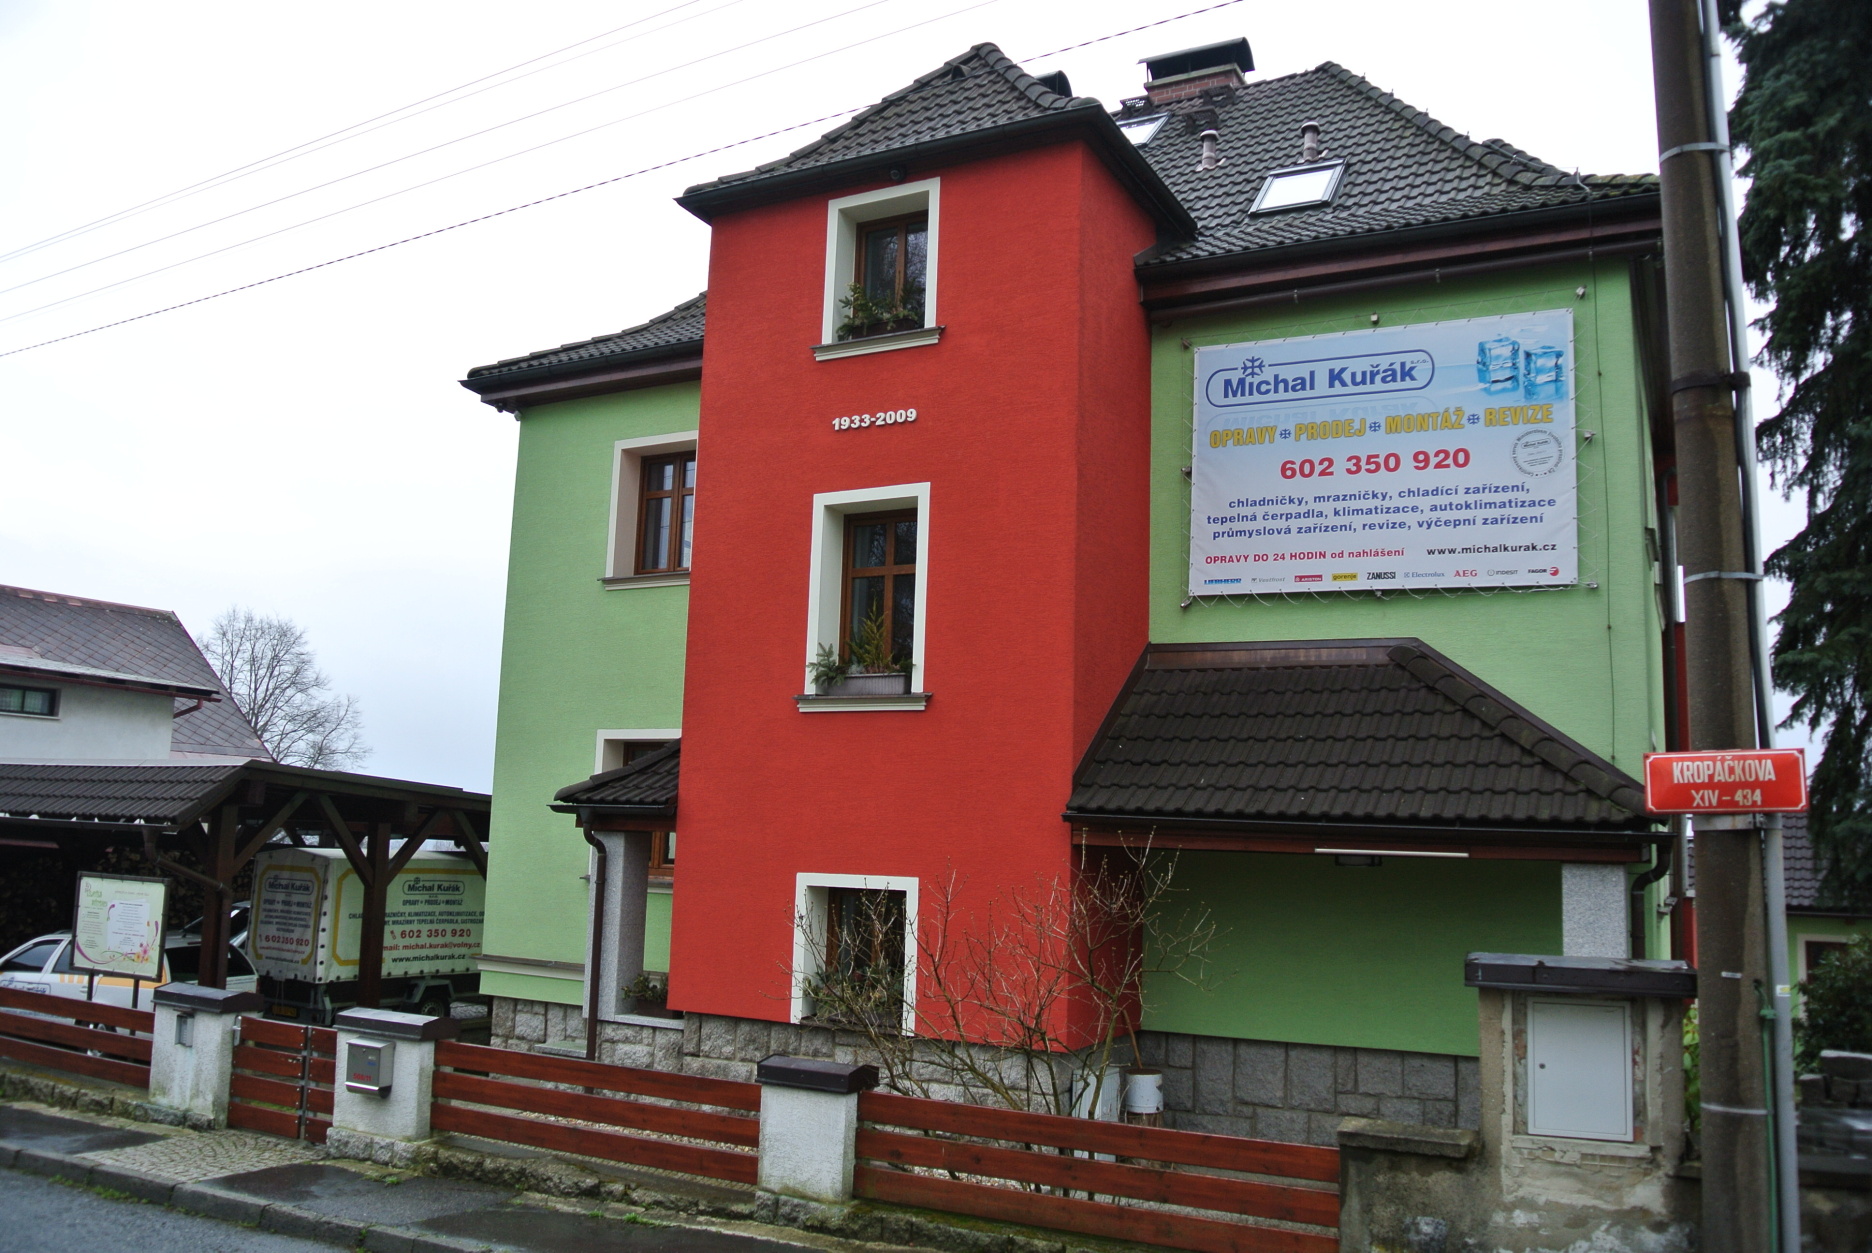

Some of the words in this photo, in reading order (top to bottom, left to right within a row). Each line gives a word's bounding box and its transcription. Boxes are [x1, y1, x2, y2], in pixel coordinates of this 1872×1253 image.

[1223, 370, 1315, 399] Michal
[1328, 360, 1418, 389] Kuřák
[832, 408, 917, 431] 1933-2009
[1209, 426, 1277, 448] OPRAVY
[1295, 418, 1367, 441] PRODEJ
[1385, 407, 1465, 435] MONTÁŽ
[1484, 404, 1554, 427] REVIZE
[1279, 457, 1335, 480] 602
[1345, 452, 1402, 475] 350
[1412, 447, 1471, 470] 920
[1228, 495, 1309, 509] chladničky,
[1313, 489, 1393, 504] mrazničky,
[1398, 485, 1459, 499] chladící
[1463, 481, 1530, 495] zařízení,
[1206, 511, 1258, 526] tepelná
[1262, 508, 1329, 522] čerpadla,
[1333, 503, 1424, 518] klimatizace,
[1429, 497, 1557, 512] autoklimatizace
[1212, 525, 1292, 541] průmyslová
[1296, 521, 1357, 534] zařízení,
[1362, 519, 1412, 531] revize,
[1417, 515, 1478, 530] výčepní
[1481, 513, 1545, 526] zařízení
[1205, 554, 1250, 565] OPRAVY
[1253, 553, 1269, 563] DO
[1272, 553, 1286, 562] 24
[1289, 551, 1327, 560] HODIN
[1330, 550, 1344, 559] od
[1347, 547, 1405, 559] nahlášení
[1426, 543, 1558, 555] www.michalkurak.cz
[1332, 573, 1357, 581] gorenje
[1366, 571, 1396, 580] ZANUSSI
[1453, 569, 1478, 578] AEG
[1672, 755, 1776, 784] KROPÁČKOVA
[1691, 789, 1719, 807] XIV
[1733, 788, 1762, 806] 434
[407, 883, 435, 892] Michal
[437, 882, 461, 892] Kuřák
[400, 929, 422, 939] 602
[426, 928, 447, 938] 350
[450, 928, 472, 938] 920
[391, 953, 466, 963] www.michalkurak.cz
